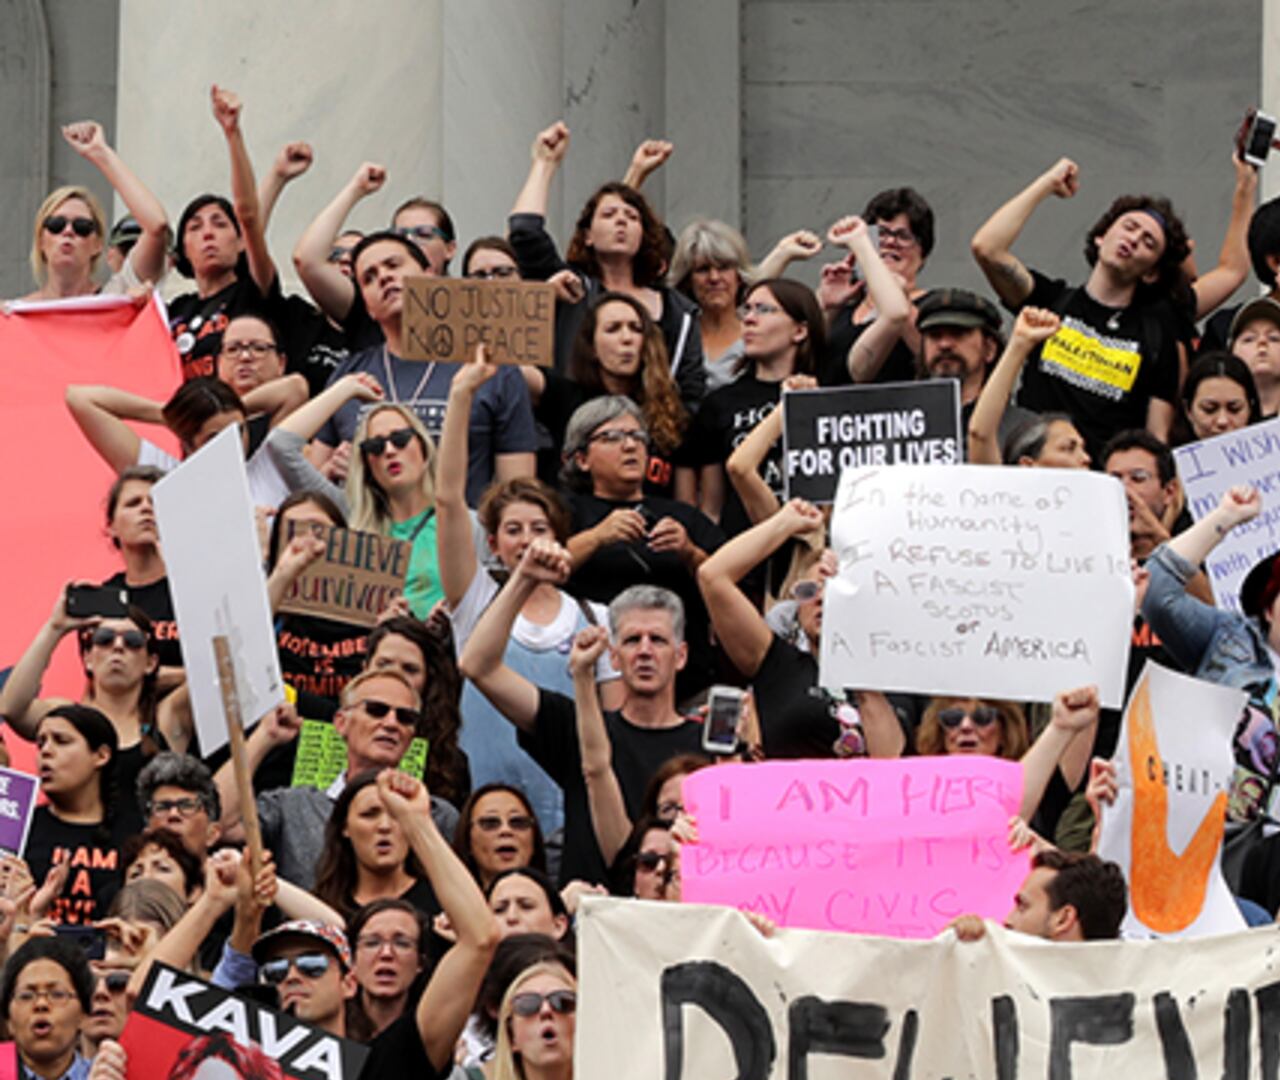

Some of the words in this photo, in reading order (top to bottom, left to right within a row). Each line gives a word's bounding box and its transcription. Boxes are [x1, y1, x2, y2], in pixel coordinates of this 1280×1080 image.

[408, 286, 450, 320] NO
[461, 286, 549, 321] JUSTICE
[464, 324, 539, 360] PEACE
[817, 409, 925, 444] FIGHTING
[788, 449, 834, 477] FOR
[839, 445, 886, 467] OUR
[892, 437, 957, 465] LIVES
[777, 776, 870, 816] AM
[71, 847, 118, 870] AM
[898, 838, 943, 868] IT
[71, 870, 92, 896] A
[825, 887, 963, 928] CIVIC
